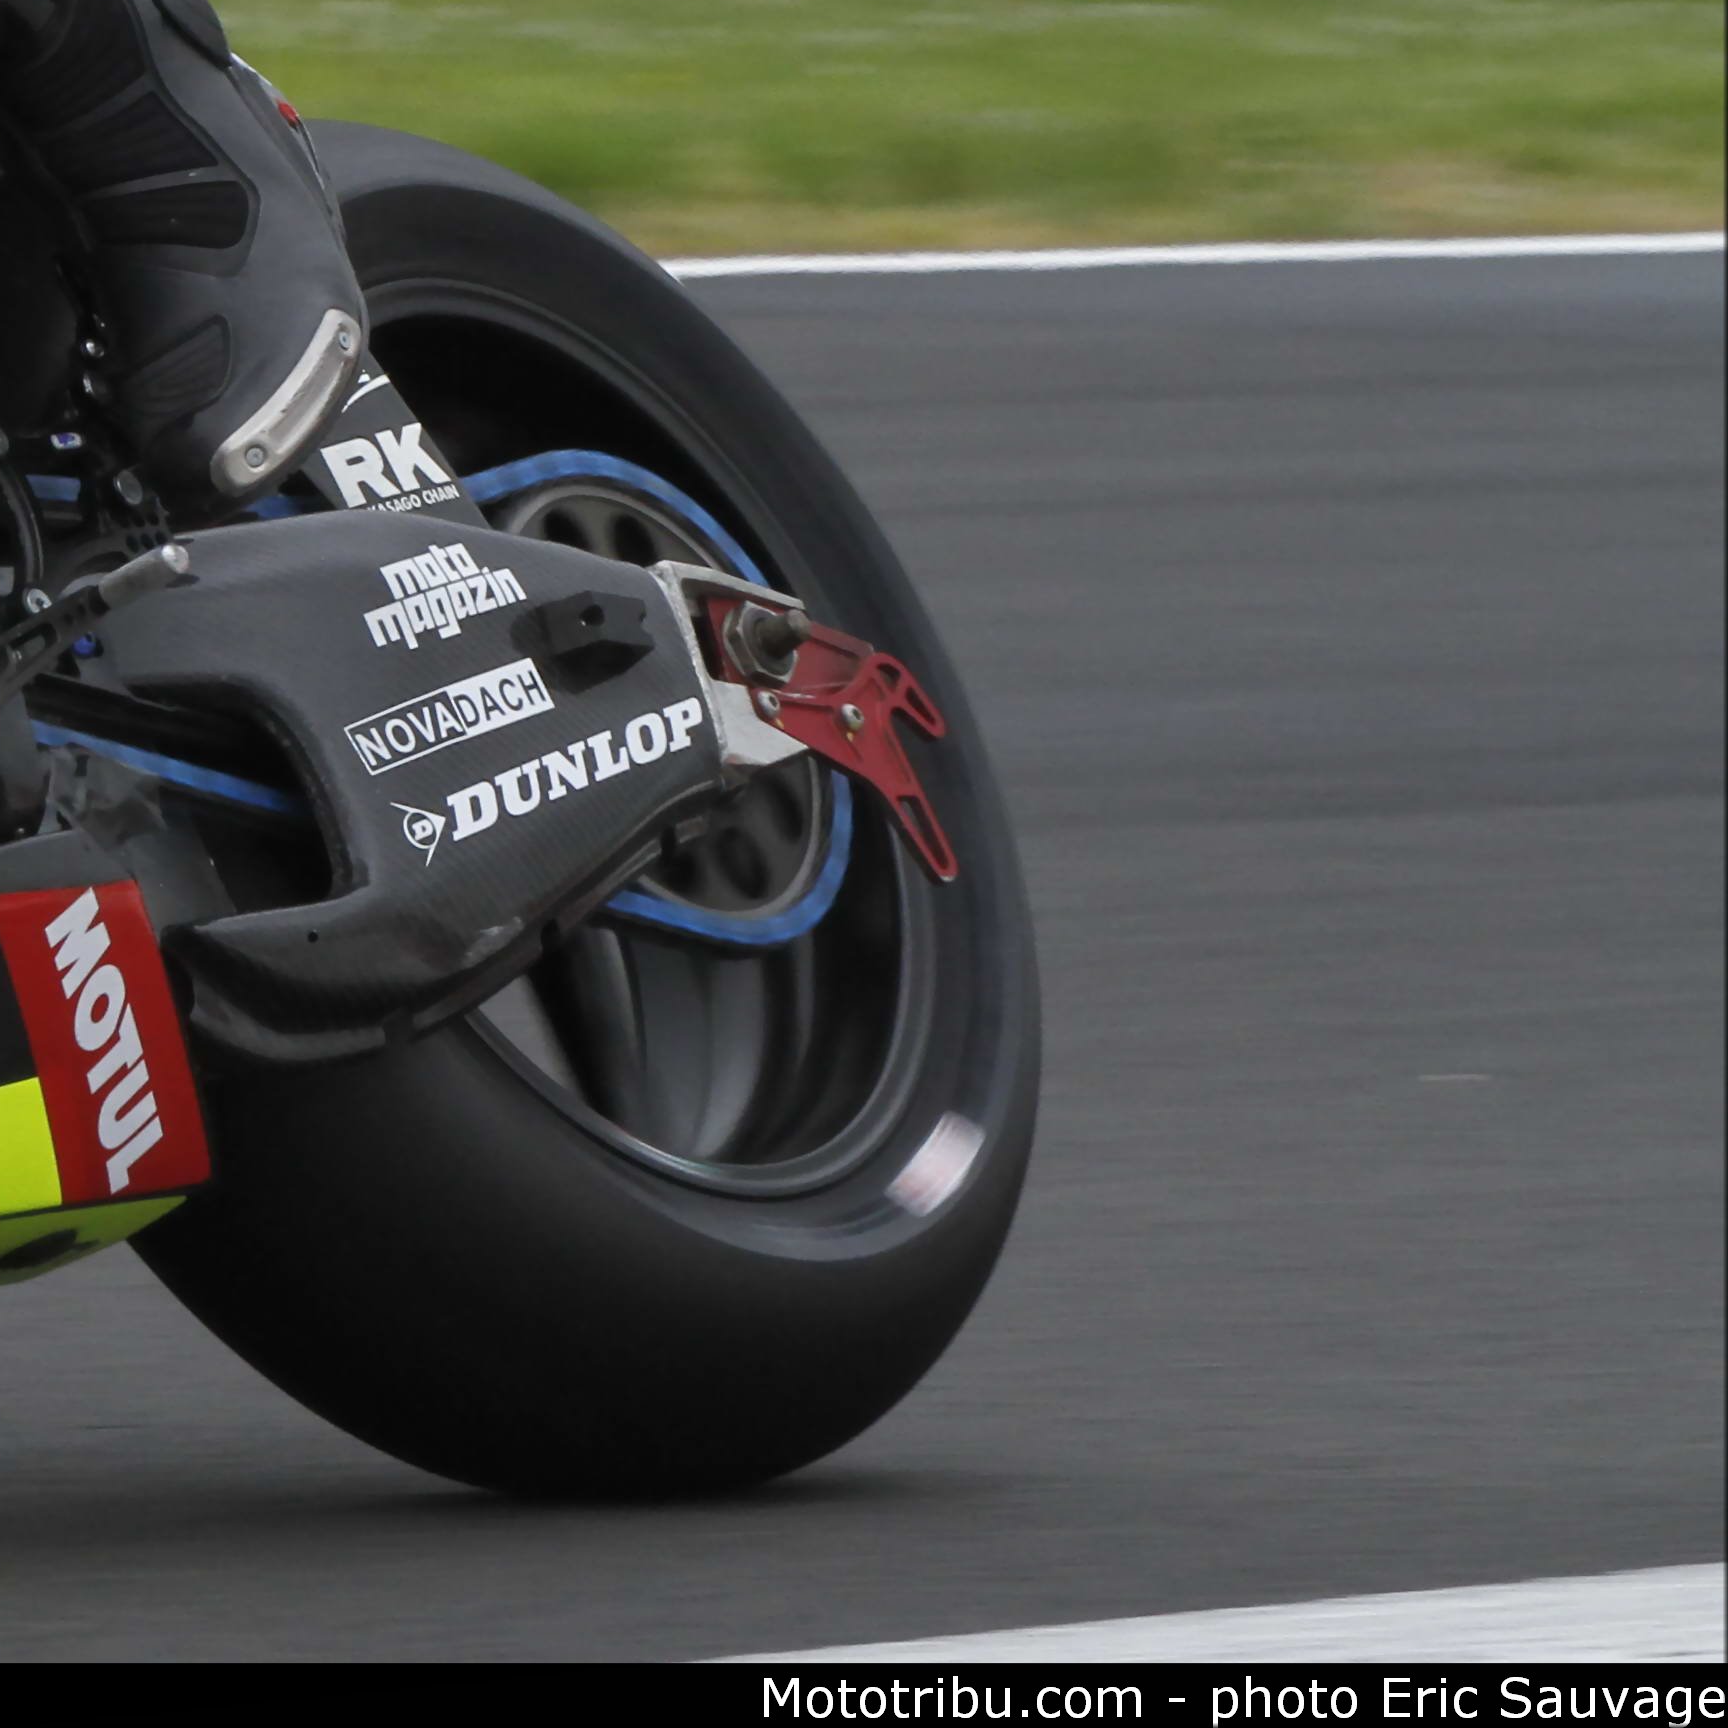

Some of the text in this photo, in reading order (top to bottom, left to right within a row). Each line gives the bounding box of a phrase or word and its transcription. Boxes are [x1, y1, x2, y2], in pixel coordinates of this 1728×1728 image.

[319, 422, 452, 509] RK
[421, 483, 461, 505] CHAIN
[362, 565, 528, 651] magazin
[380, 542, 475, 601] moto
[445, 697, 705, 843] DUNLOP
[45, 887, 167, 1196] MOTUL
